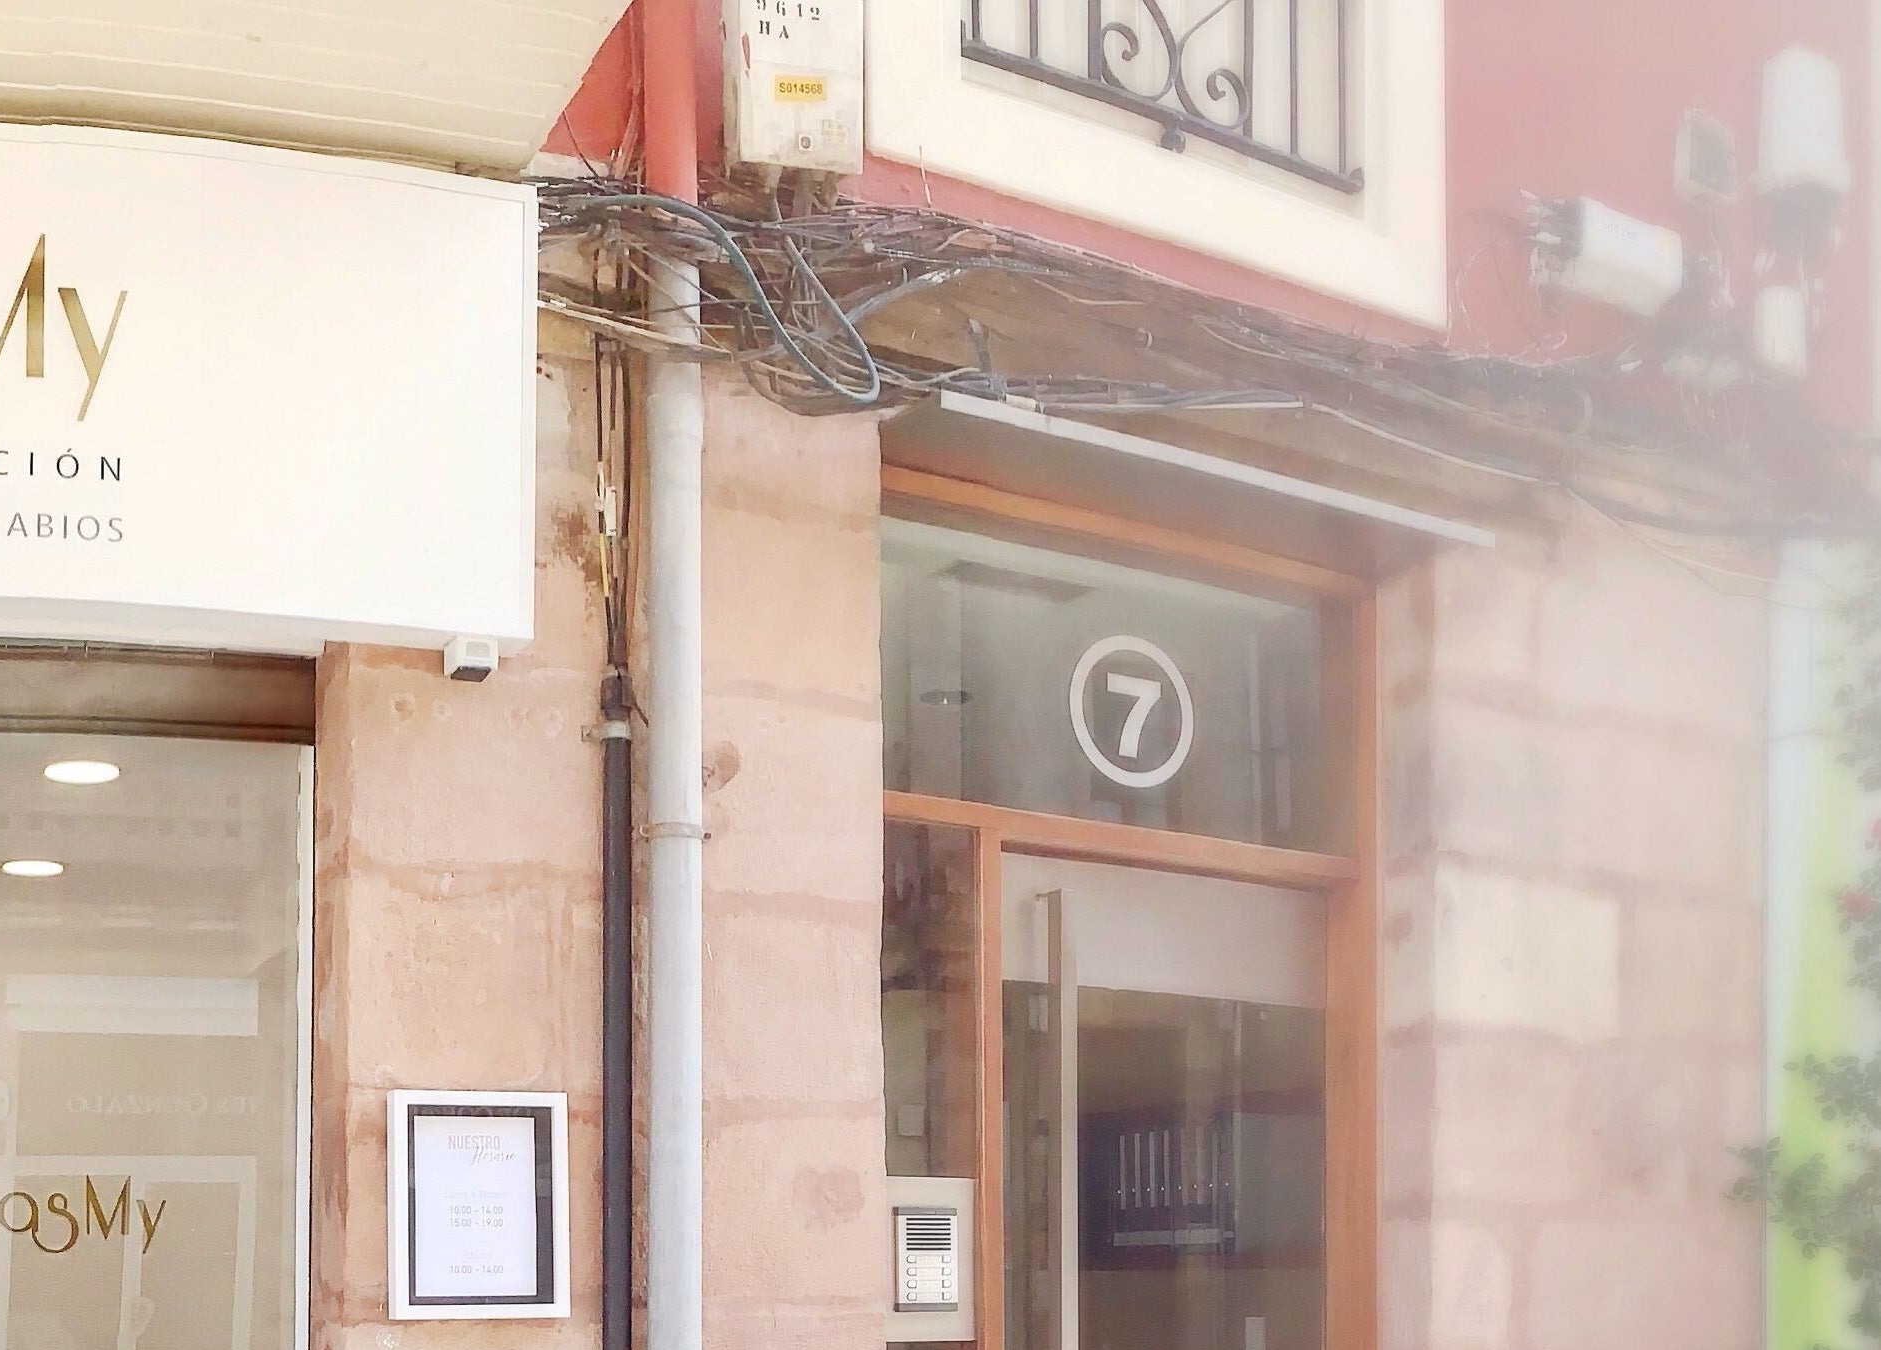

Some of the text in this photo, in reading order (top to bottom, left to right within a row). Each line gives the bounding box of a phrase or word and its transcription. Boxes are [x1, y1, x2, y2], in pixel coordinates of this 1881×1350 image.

[1107, 671, 1162, 759] 7
[448, 1135, 501, 1150] NUESTRO
[450, 1205, 471, 1214] 1000
[482, 1205, 503, 1214] 1400
[450, 1218, 471, 1227] 1500
[482, 1218, 503, 1227] 1900
[450, 1265, 472, 1273] 1000
[482, 1265, 504, 1273] 1400
